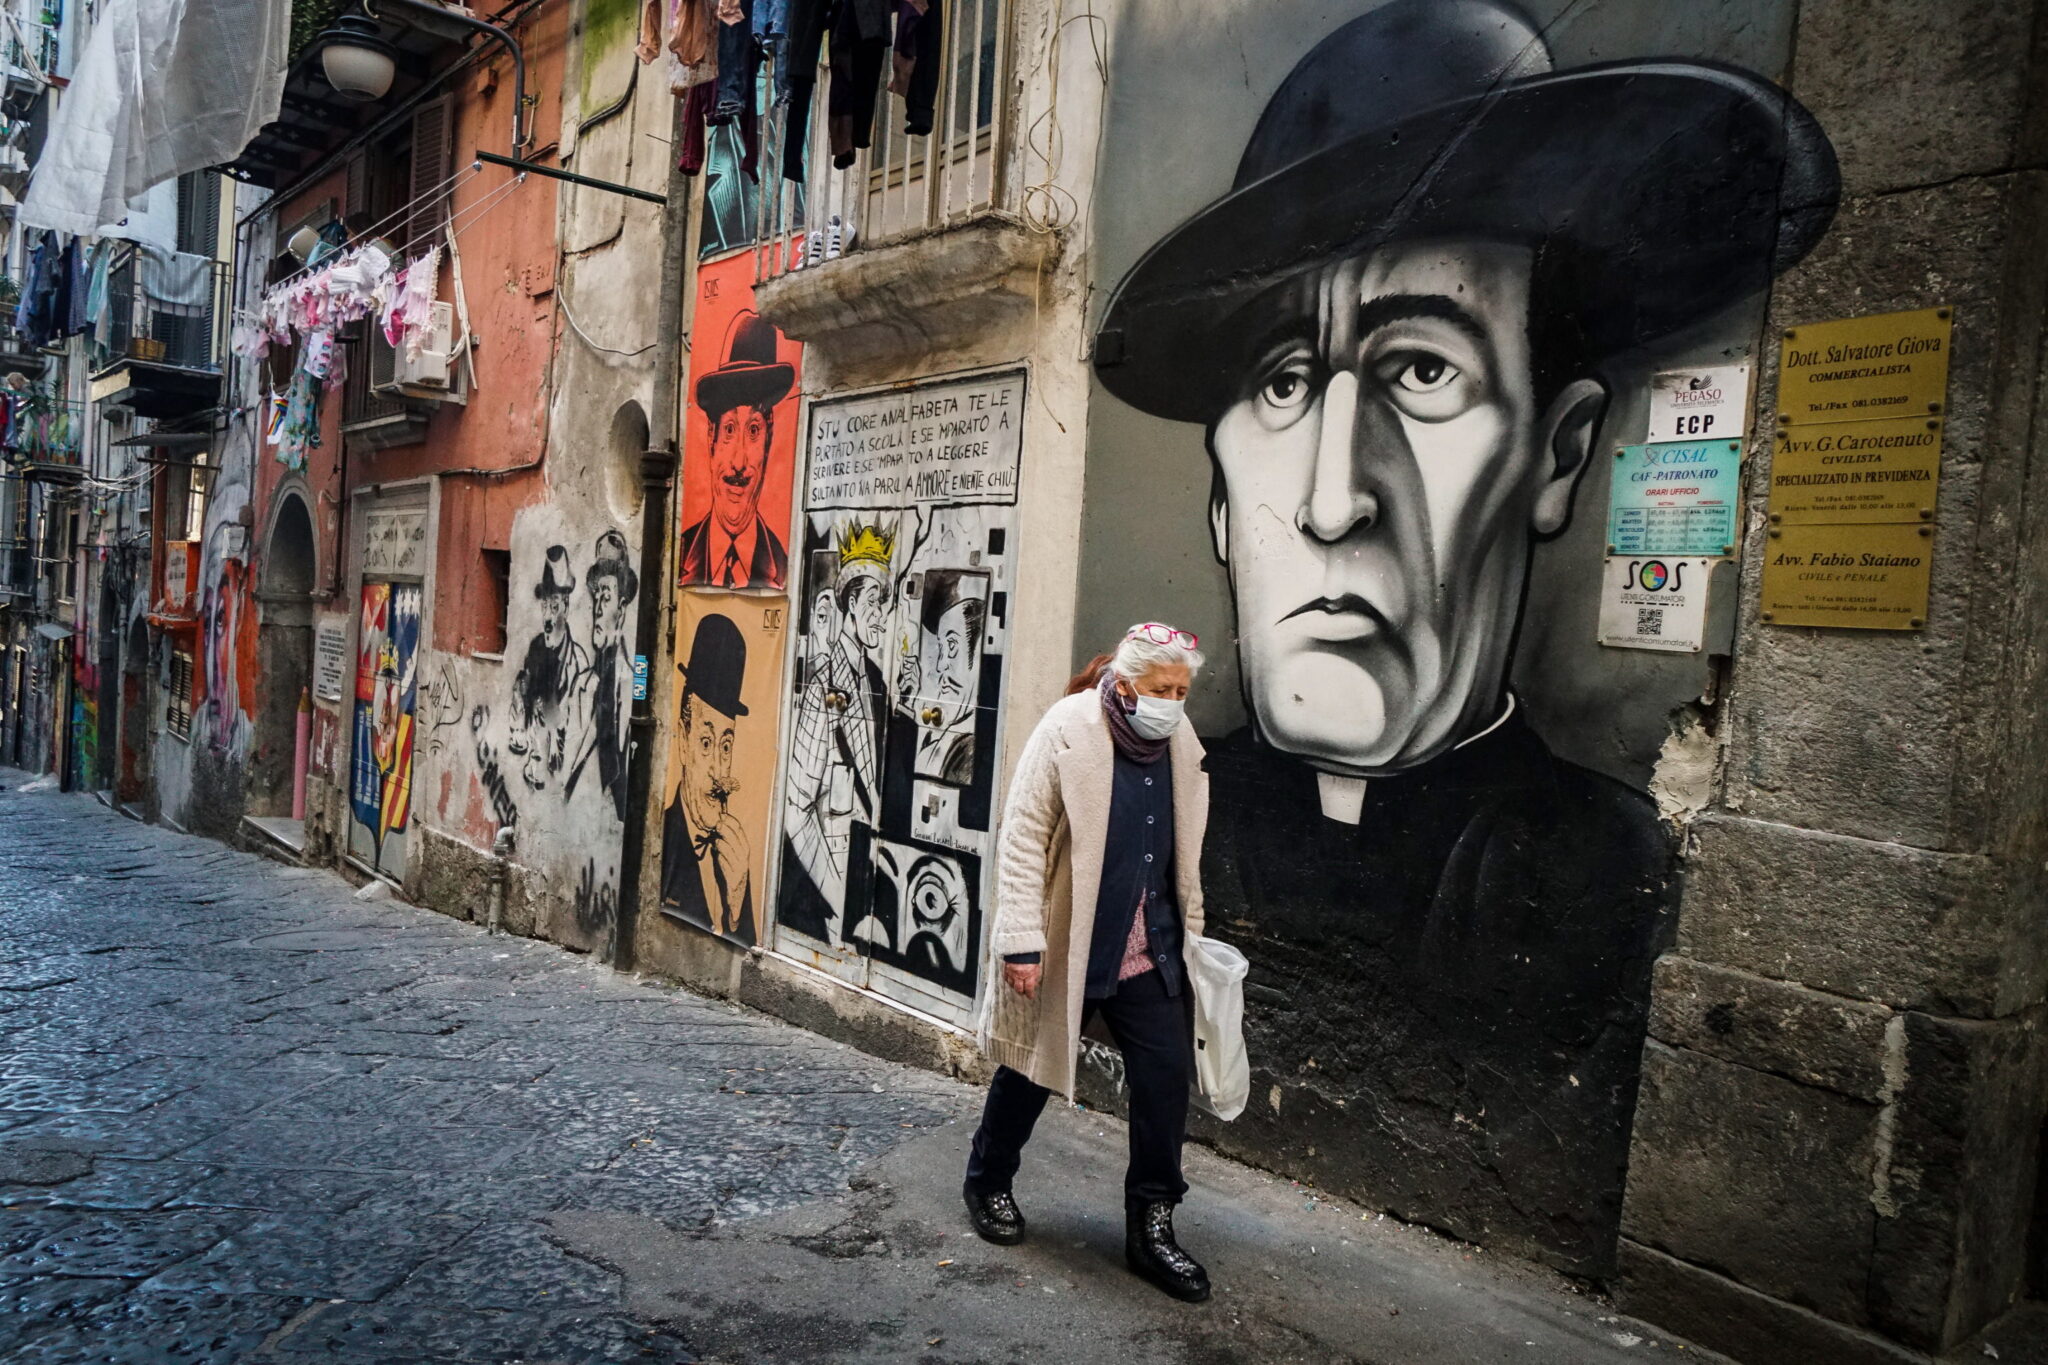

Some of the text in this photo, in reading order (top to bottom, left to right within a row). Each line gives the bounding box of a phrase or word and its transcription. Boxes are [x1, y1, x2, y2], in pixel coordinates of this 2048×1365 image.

[1786, 336, 1942, 368] Dott. Salvatore Giova
[1808, 364, 1911, 383] COMMERCIALISTA
[1674, 388, 1722, 402] PEGASO
[818, 418, 840, 440] STU
[848, 414, 878, 433] CORE
[858, 440, 864, 454] A
[911, 430, 917, 444] E
[920, 427, 934, 443] SE
[999, 410, 1009, 430] A
[1676, 414, 1714, 435] ECP
[813, 461, 850, 480] SCRIVERE
[926, 448, 934, 462] A
[937, 441, 989, 460] LEGGERE
[1662, 448, 1708, 464] CISAL
[1822, 454, 1882, 464] CIVILISTA
[914, 470, 951, 498] AMMORE
[952, 476, 958, 490] E
[959, 470, 985, 490] NIENTE
[1776, 470, 1930, 486] SPECIALIZZATO IN PREVIDENZA
[1670, 488, 1700, 496] UFFICIO
[1773, 553, 1920, 567] Avv. Fabio Staiano
[1622, 560, 1688, 592] SOS
[1798, 573, 1832, 581] CIVILE
[1844, 574, 1888, 582] PENALE
